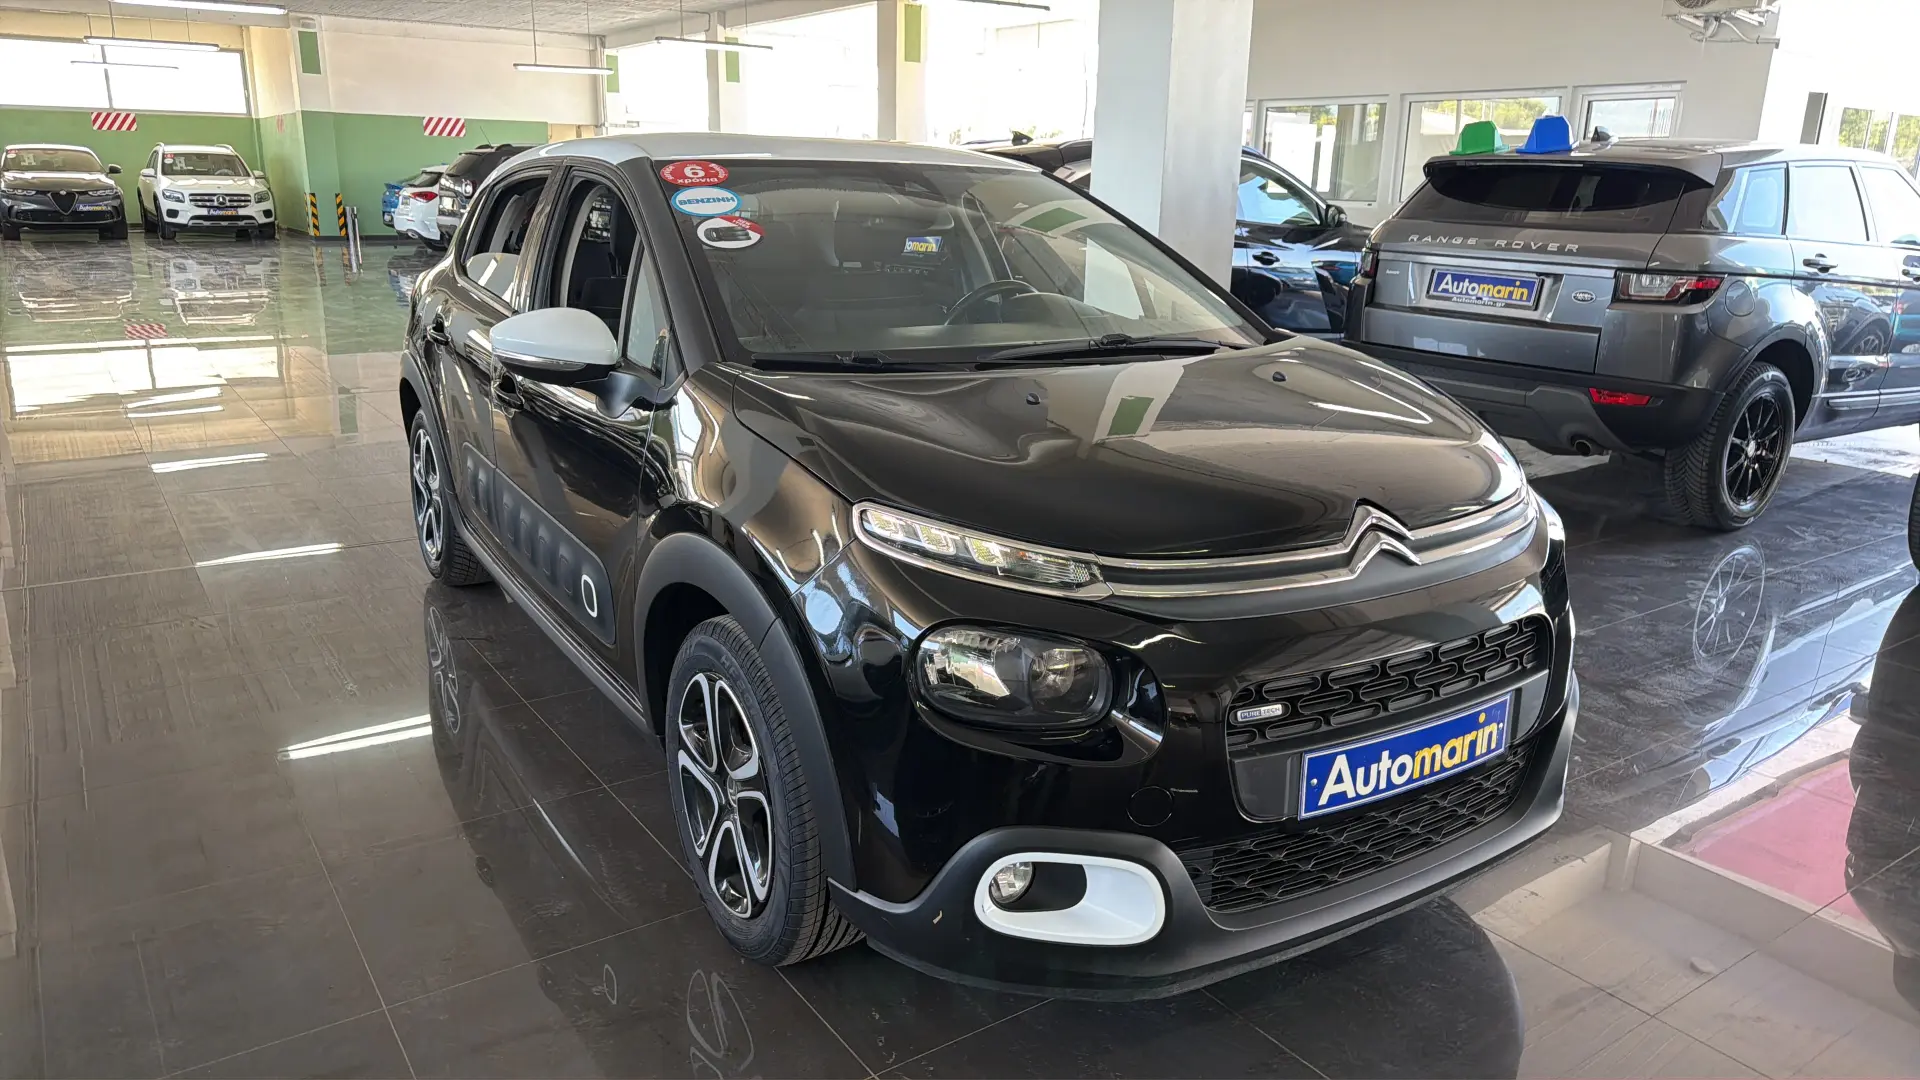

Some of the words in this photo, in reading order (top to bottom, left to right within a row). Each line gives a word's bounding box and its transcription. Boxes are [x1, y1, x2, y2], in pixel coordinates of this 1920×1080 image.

[683, 165, 706, 178] 6
[1408, 234, 1479, 245] RANGE
[1494, 239, 1579, 252] ROVER
[1438, 273, 1529, 301] Automarin
[1317, 712, 1498, 807] Automarin
